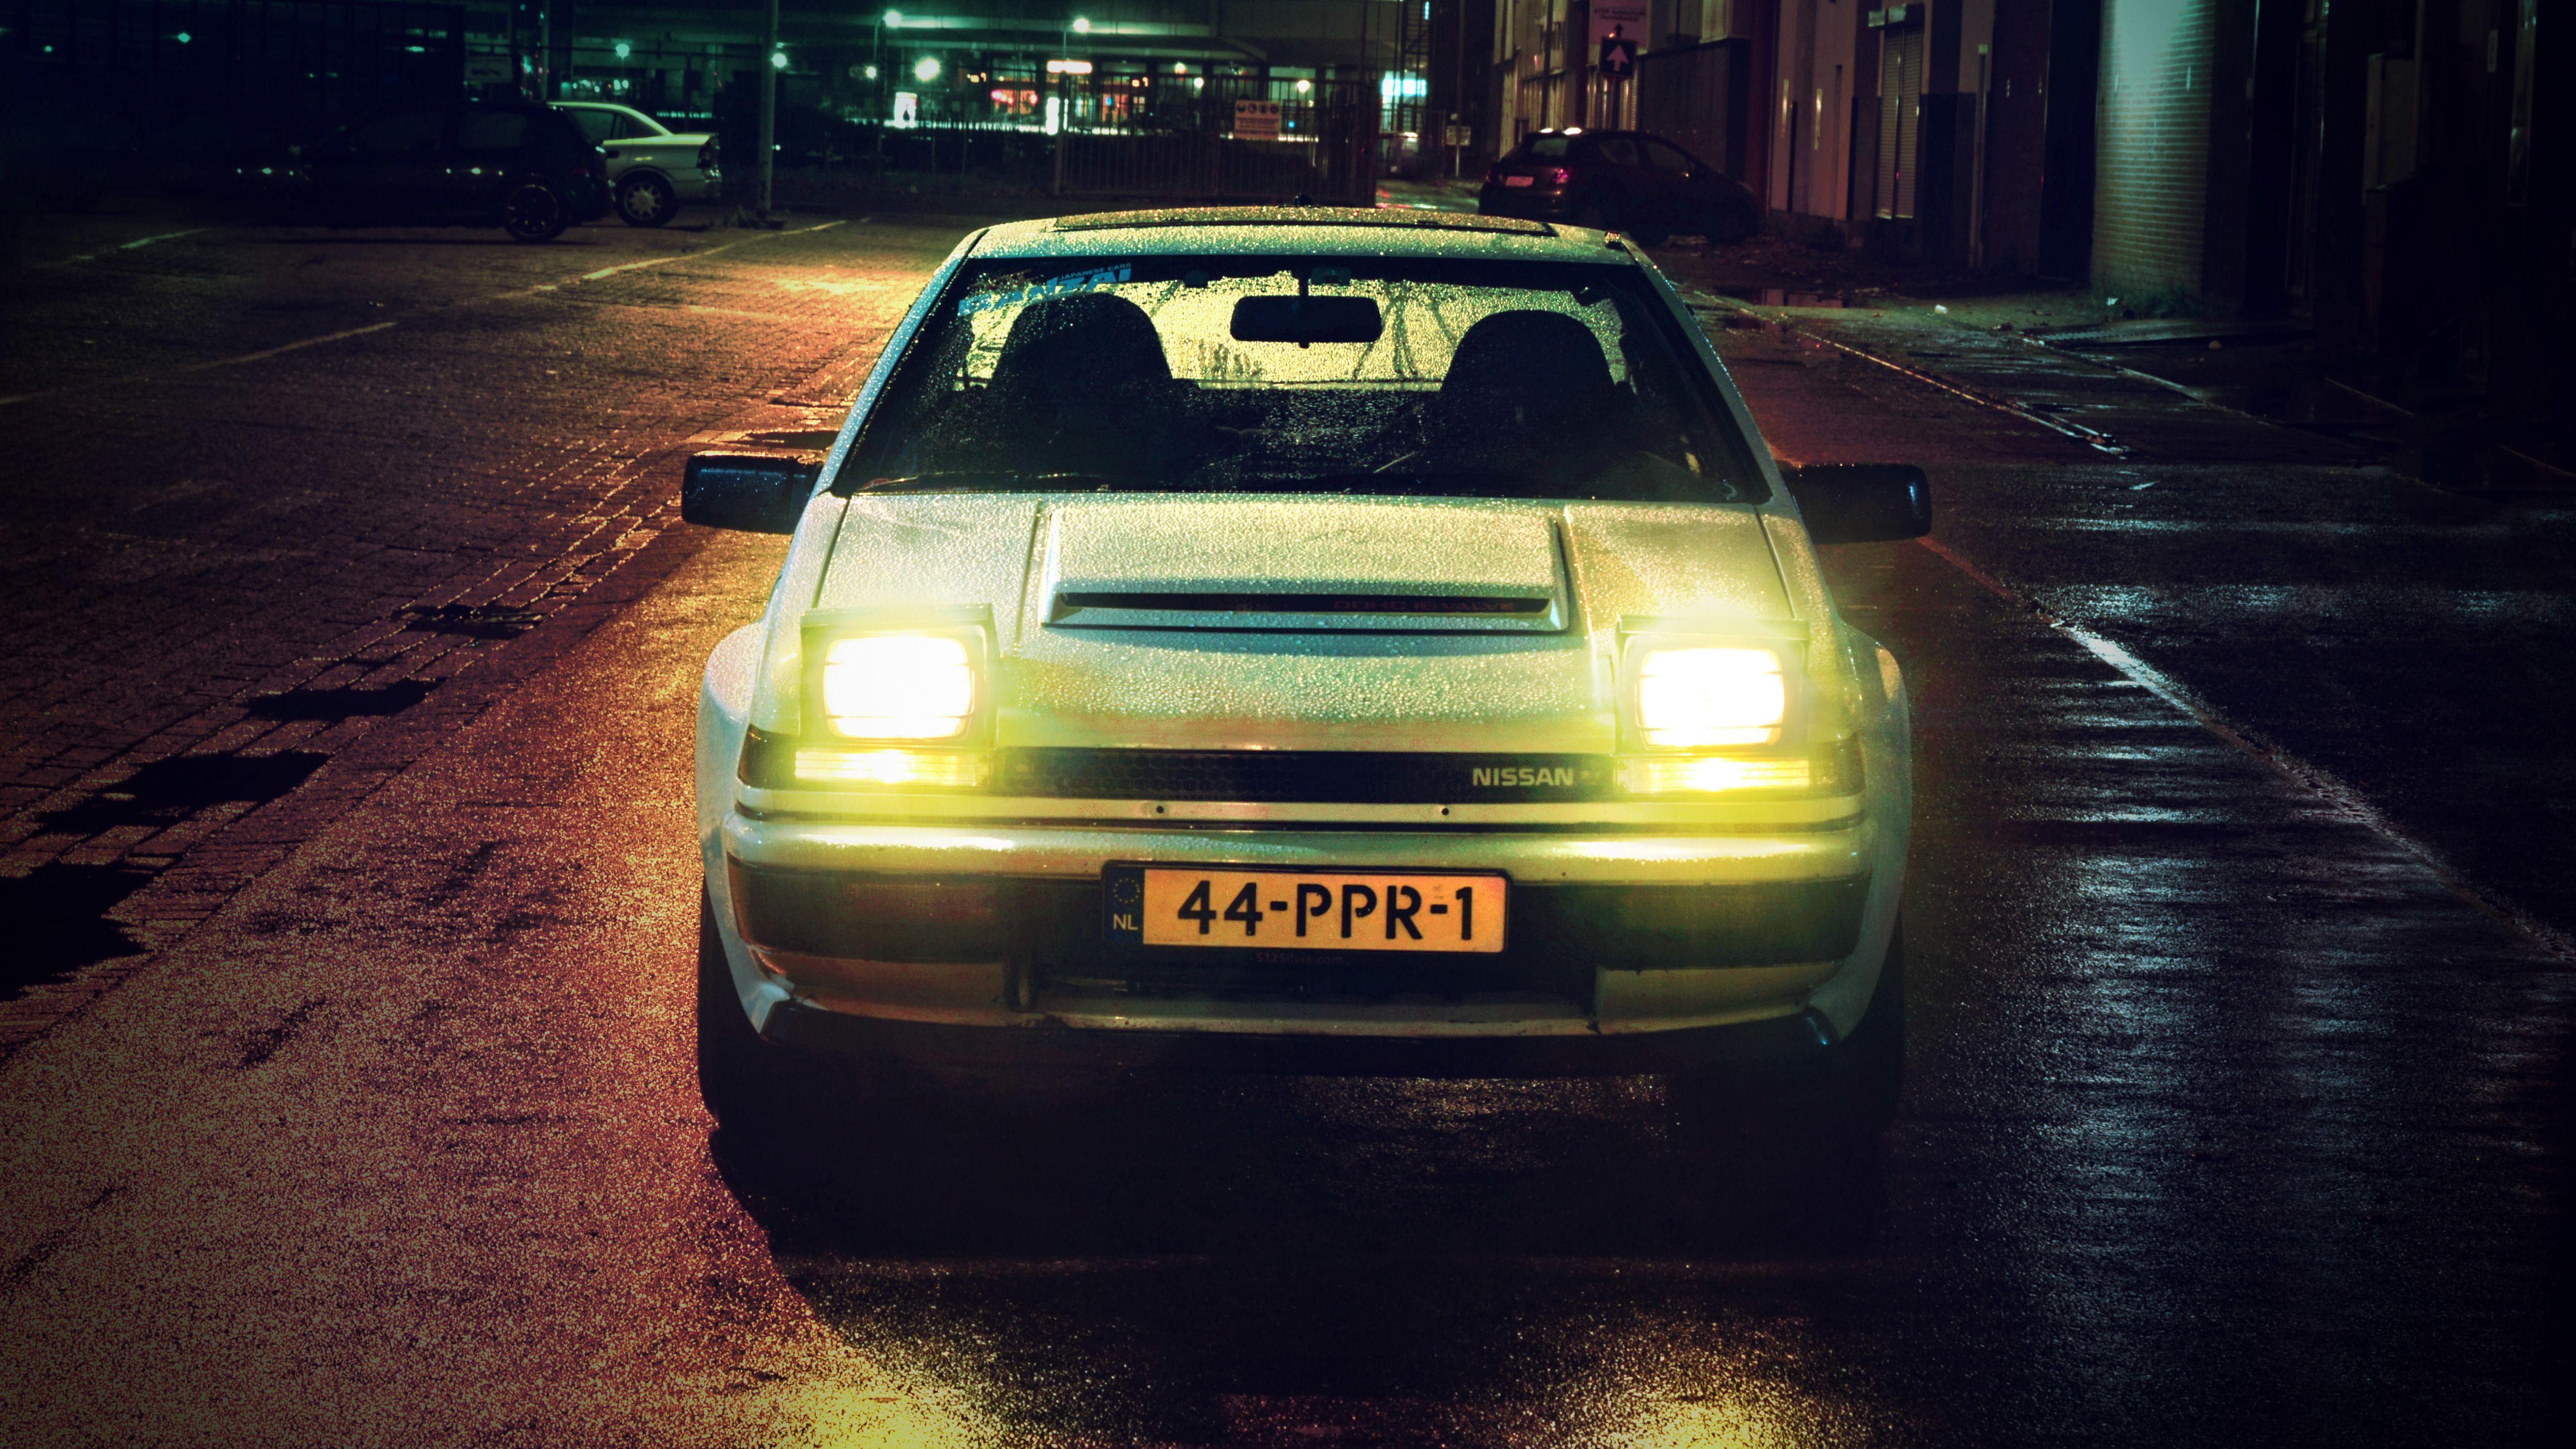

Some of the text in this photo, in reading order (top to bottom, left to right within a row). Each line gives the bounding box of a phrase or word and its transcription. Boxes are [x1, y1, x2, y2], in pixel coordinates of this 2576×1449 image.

[1060, 262, 1132, 280] JAPANESE CARS
[1334, 601, 1407, 611] DOHC
[1473, 767, 1573, 786] NISSAN
[1178, 881, 1473, 940] 44-PPR-1
[1113, 913, 1138, 930] NL
